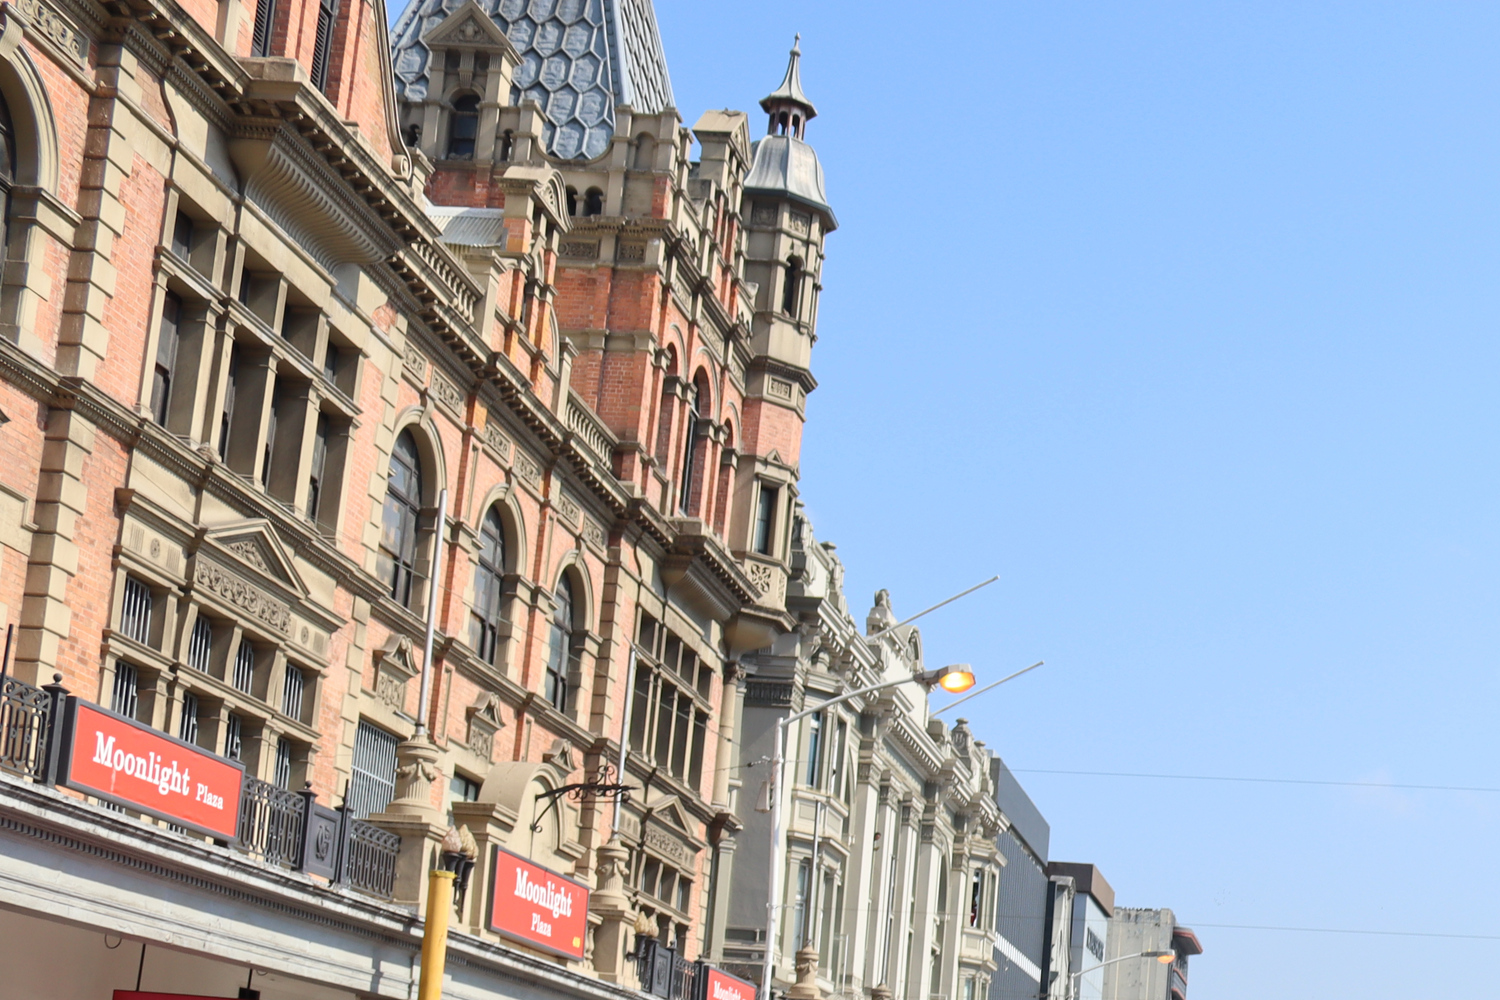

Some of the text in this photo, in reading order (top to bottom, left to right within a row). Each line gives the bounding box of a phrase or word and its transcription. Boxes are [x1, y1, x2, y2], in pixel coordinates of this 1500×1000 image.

[92, 731, 223, 810] Moonlight Plaza
[514, 867, 572, 918] Moonlight
[531, 912, 552, 937] Plaza
